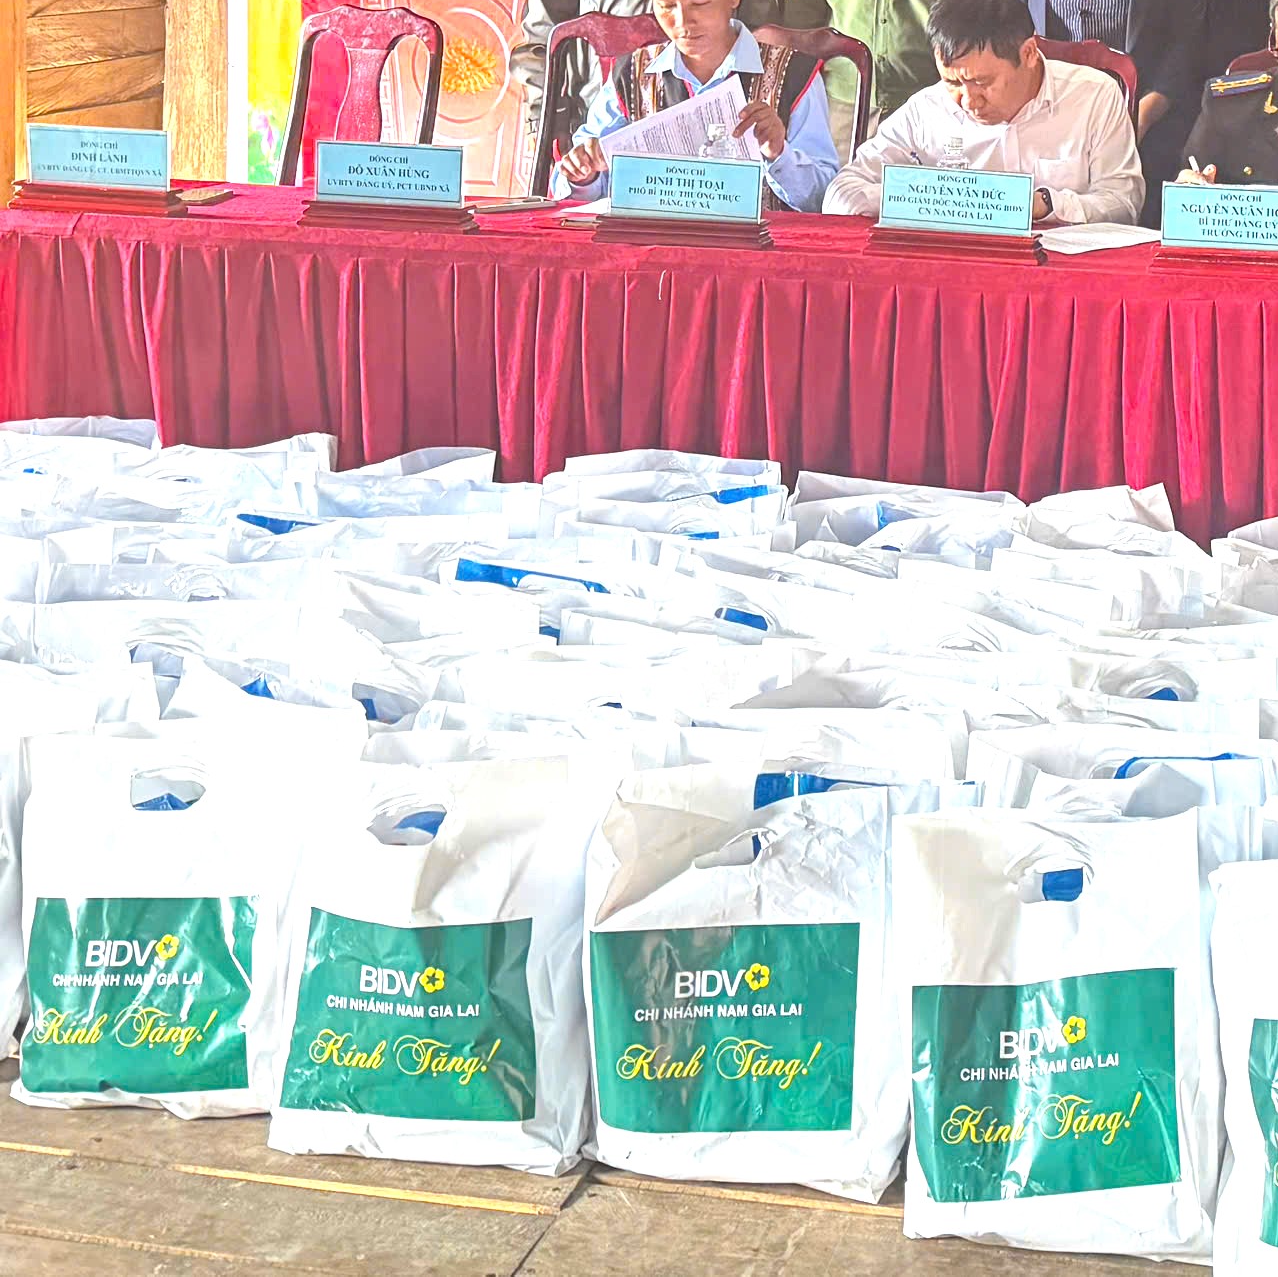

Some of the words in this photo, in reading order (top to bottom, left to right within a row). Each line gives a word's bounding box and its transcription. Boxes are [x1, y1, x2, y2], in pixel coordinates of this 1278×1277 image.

[85, 938, 158, 967] BIDV
[359, 964, 421, 998] BIDV
[674, 968, 746, 999] BIDV
[326, 994, 347, 1010] CHI
[349, 995, 393, 1015] NHÁNH
[396, 1003, 425, 1018] NAM
[428, 1004, 453, 1019] GIA
[457, 1003, 480, 1017] LAI
[634, 1008, 659, 1022] CHI
[663, 1001, 714, 1020] NHÁNH
[717, 1004, 748, 1018] NAM
[752, 1004, 776, 1017] GIA
[780, 1002, 802, 1017] LAI
[309, 1028, 388, 1070] Kính
[393, 1034, 501, 1086] Tặng!
[616, 1043, 707, 1081] Kính
[712, 1036, 822, 1090] Tặng!
[960, 1067, 985, 1082] CHI
[1070, 1056, 1094, 1071] GIA
[1098, 1052, 1119, 1067] LAI
[1035, 1091, 1142, 1146] Tặng!
